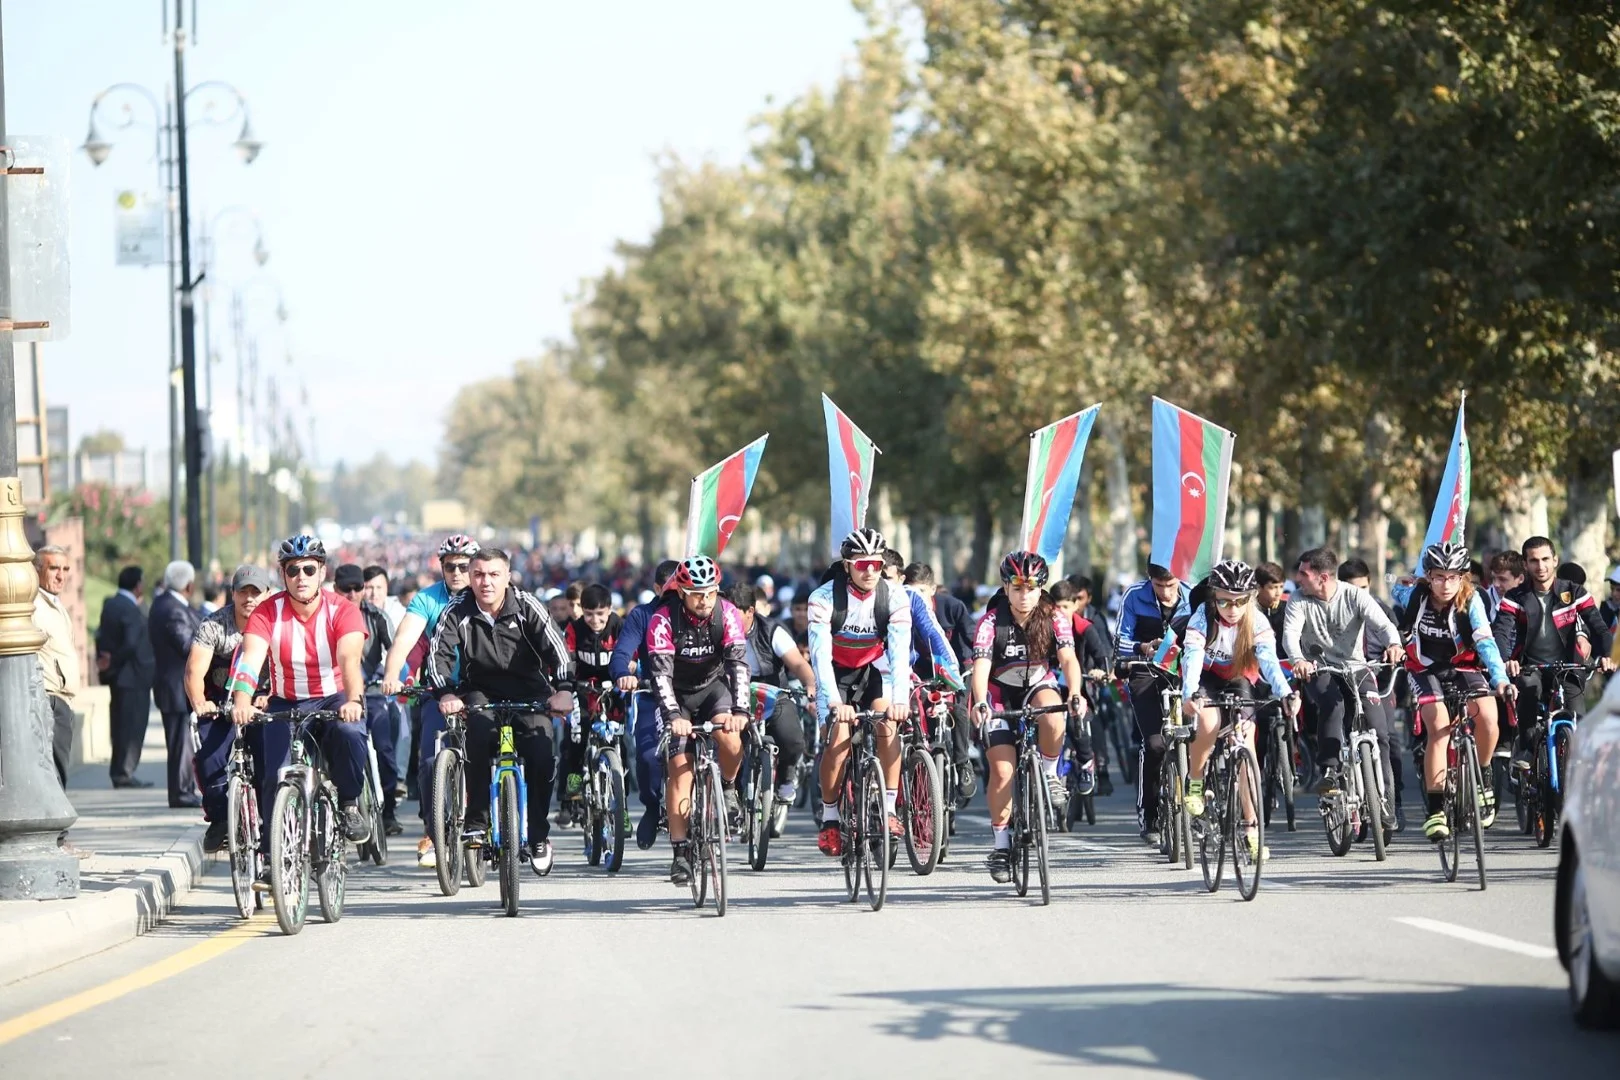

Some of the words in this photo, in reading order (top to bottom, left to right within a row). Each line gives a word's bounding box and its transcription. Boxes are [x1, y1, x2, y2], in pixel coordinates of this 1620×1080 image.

[1418, 623, 1452, 639] BAK
[680, 645, 715, 657] BAKU
[1004, 644, 1027, 657] BA
[654, 706, 665, 738] BAK
